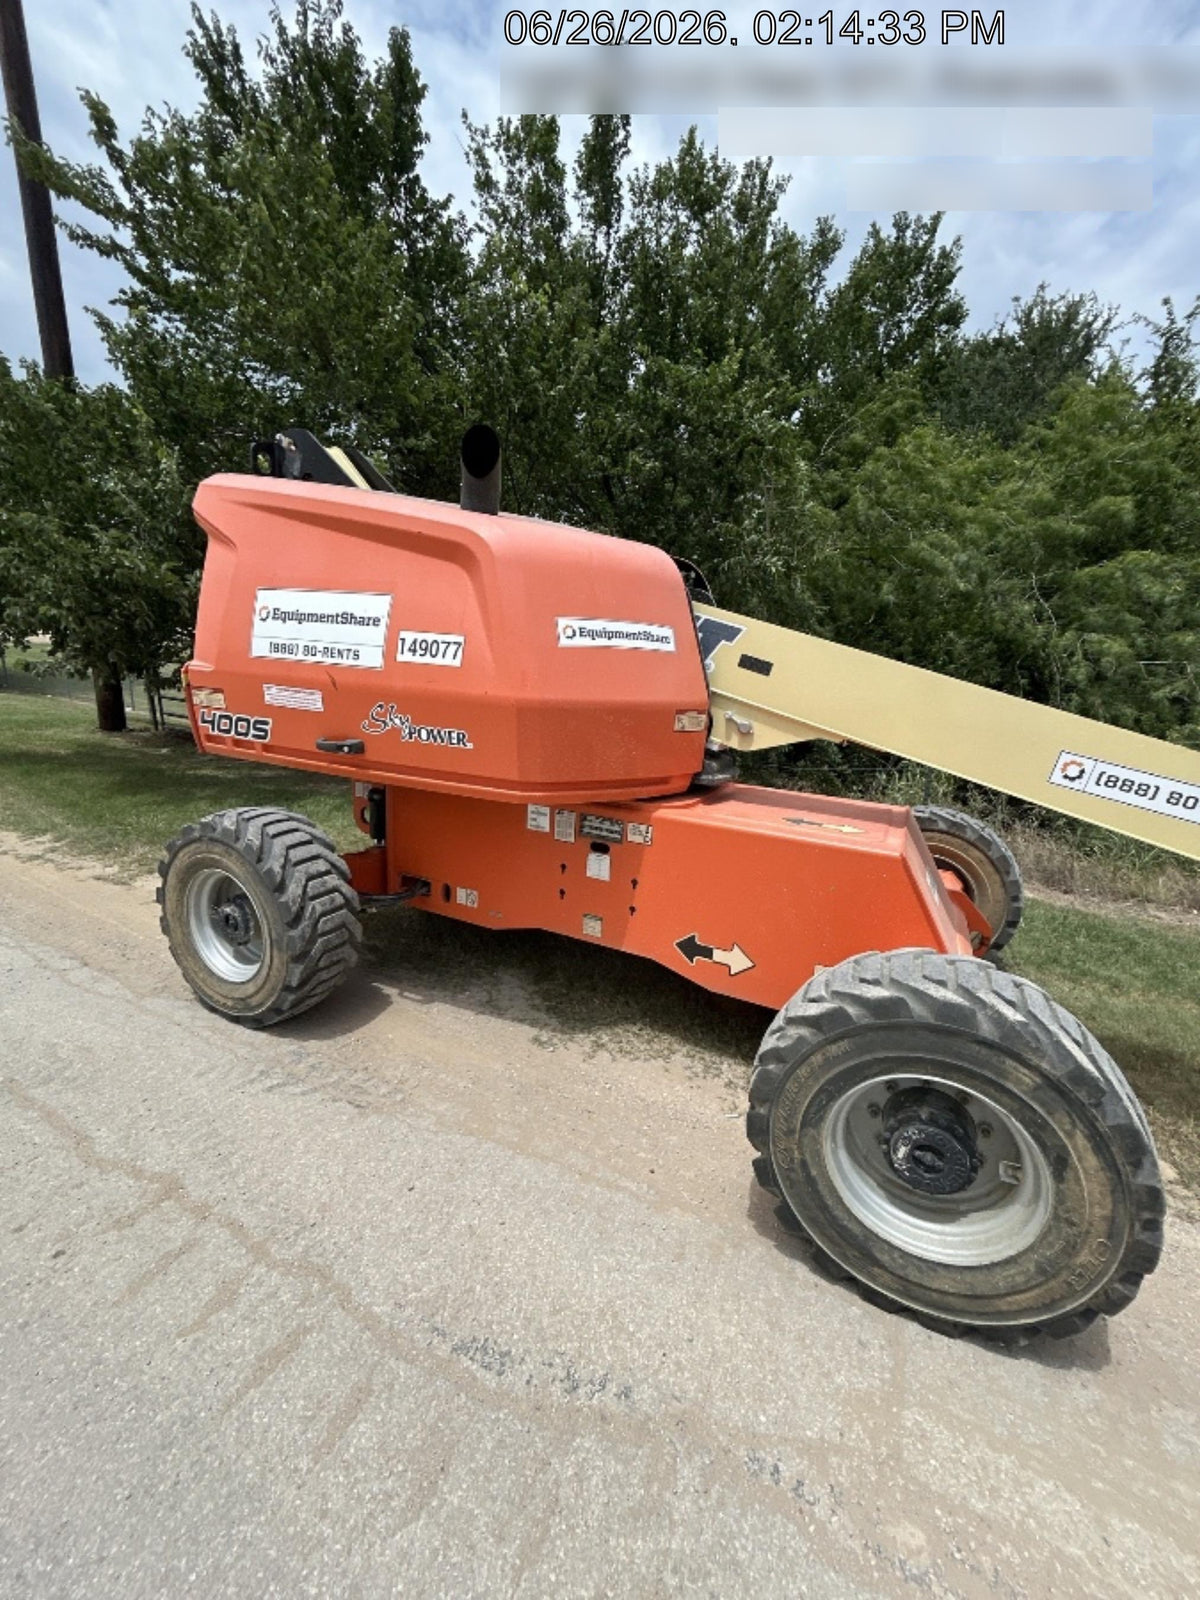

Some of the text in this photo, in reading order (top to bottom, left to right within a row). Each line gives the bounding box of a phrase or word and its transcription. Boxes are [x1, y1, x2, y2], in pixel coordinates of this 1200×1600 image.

[271, 607, 381, 627] EquipmentShare
[578, 626, 671, 644] EquipmentShare
[302, 645, 360, 660] 80-RENTS
[399, 637, 463, 660] 149077
[200, 710, 270, 741] 400S
[406, 725, 469, 748] POWER
